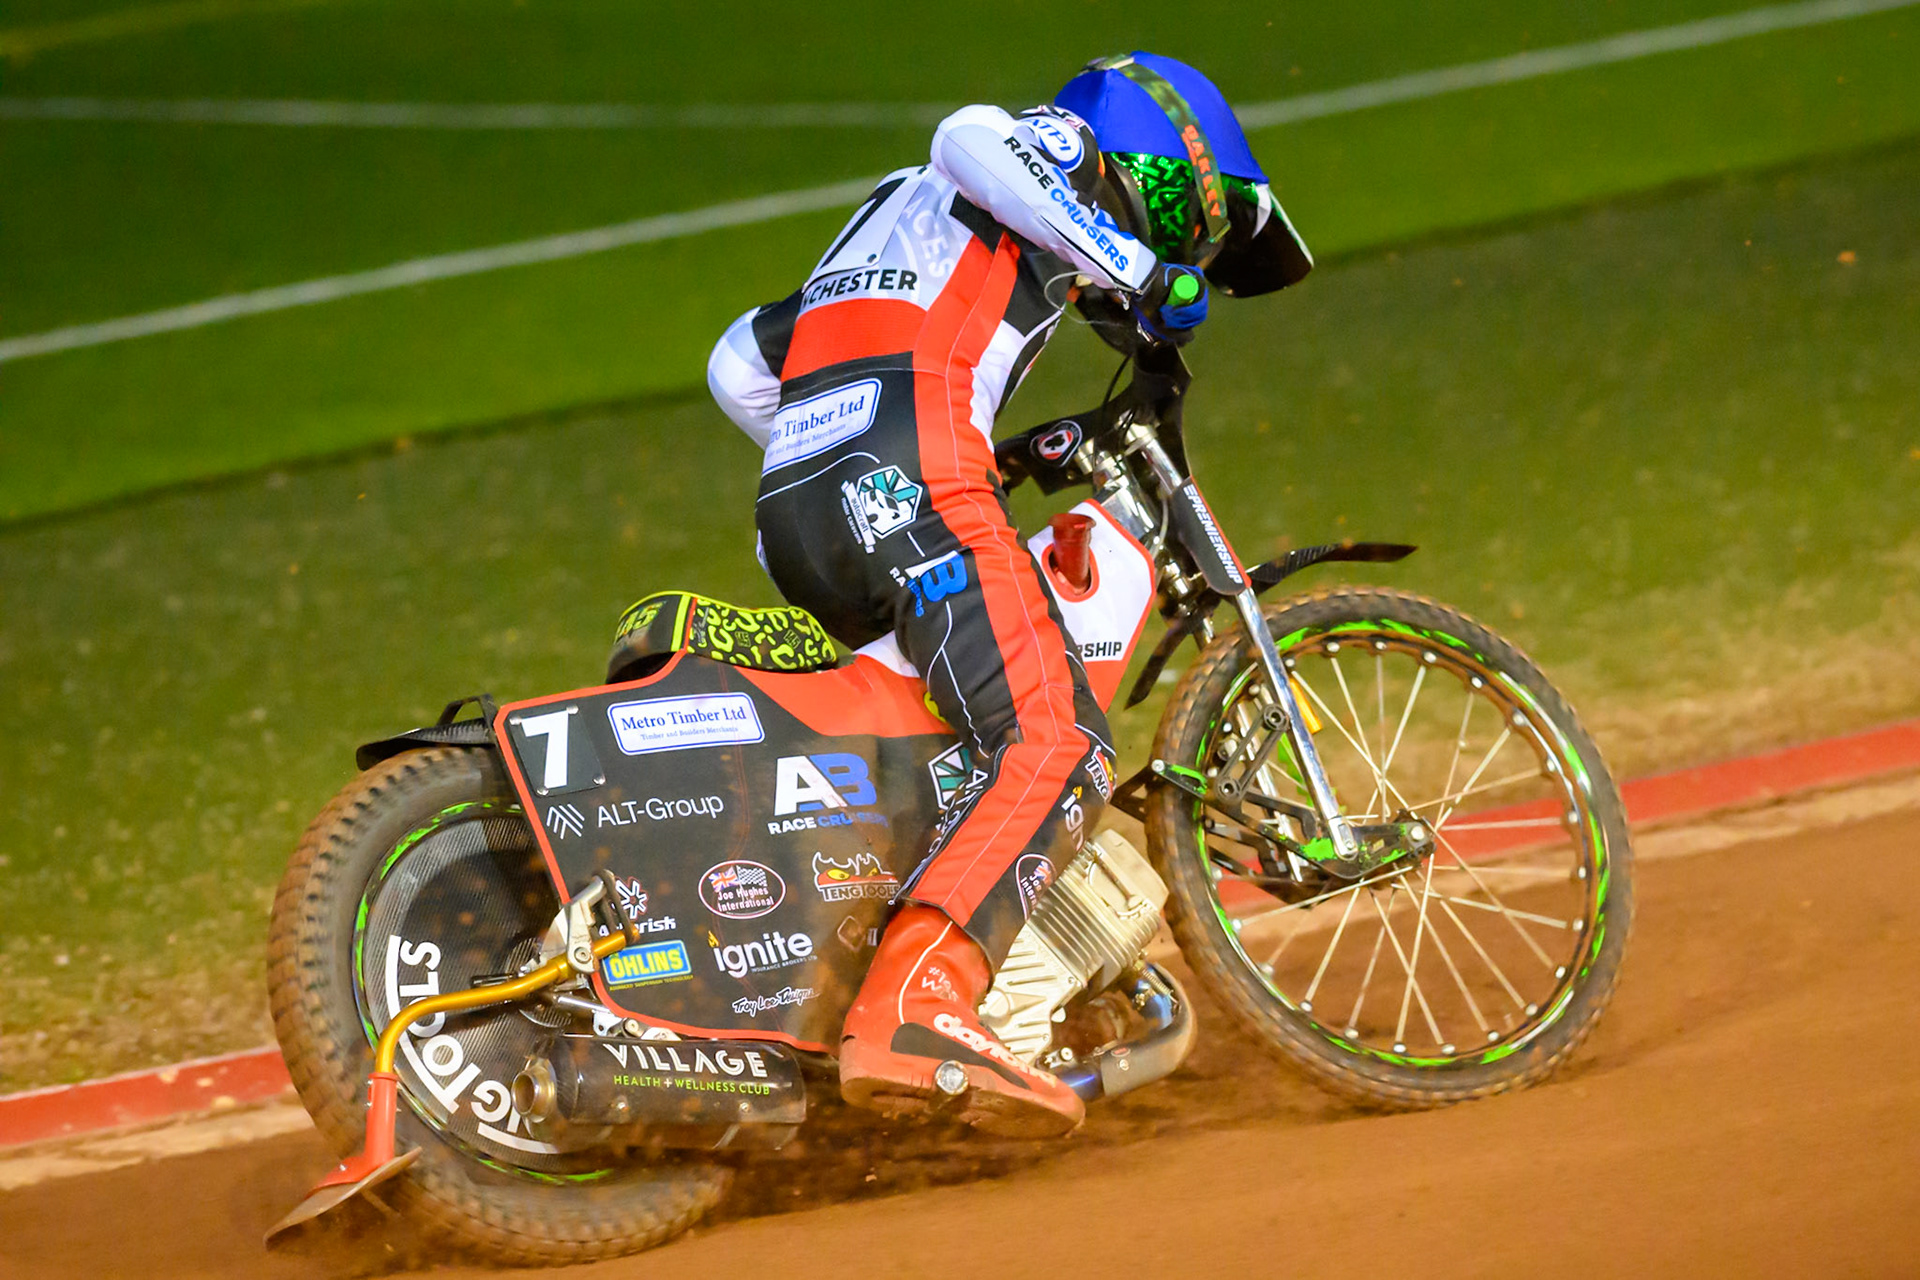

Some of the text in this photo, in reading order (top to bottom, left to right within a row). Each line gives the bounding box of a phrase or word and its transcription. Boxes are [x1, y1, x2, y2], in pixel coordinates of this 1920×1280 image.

[1184, 124, 1222, 217] OAKLEY
[1003, 136, 1055, 190] RACE
[1050, 187, 1129, 273] CRUISERS
[902, 194, 956, 279] ACES
[784, 410, 836, 438] Timber
[838, 395, 866, 418] Ltd
[620, 706, 747, 731] Metro Timber Ltd
[521, 709, 570, 789] 7
[774, 753, 877, 816] AB
[597, 795, 725, 828] ALT-Group
[767, 816, 817, 835] RACE
[717, 886, 769, 901] Joe Hughes
[1029, 874, 1042, 891] Joe
[717, 896, 775, 912] International
[712, 931, 813, 979] ignite
[732, 997, 757, 1018] Troy
[602, 1043, 769, 1078] VILLAGE
[613, 1075, 661, 1087] HEALTH
[674, 1078, 736, 1094] WELLNESS
[738, 1083, 770, 1095] CLUB
